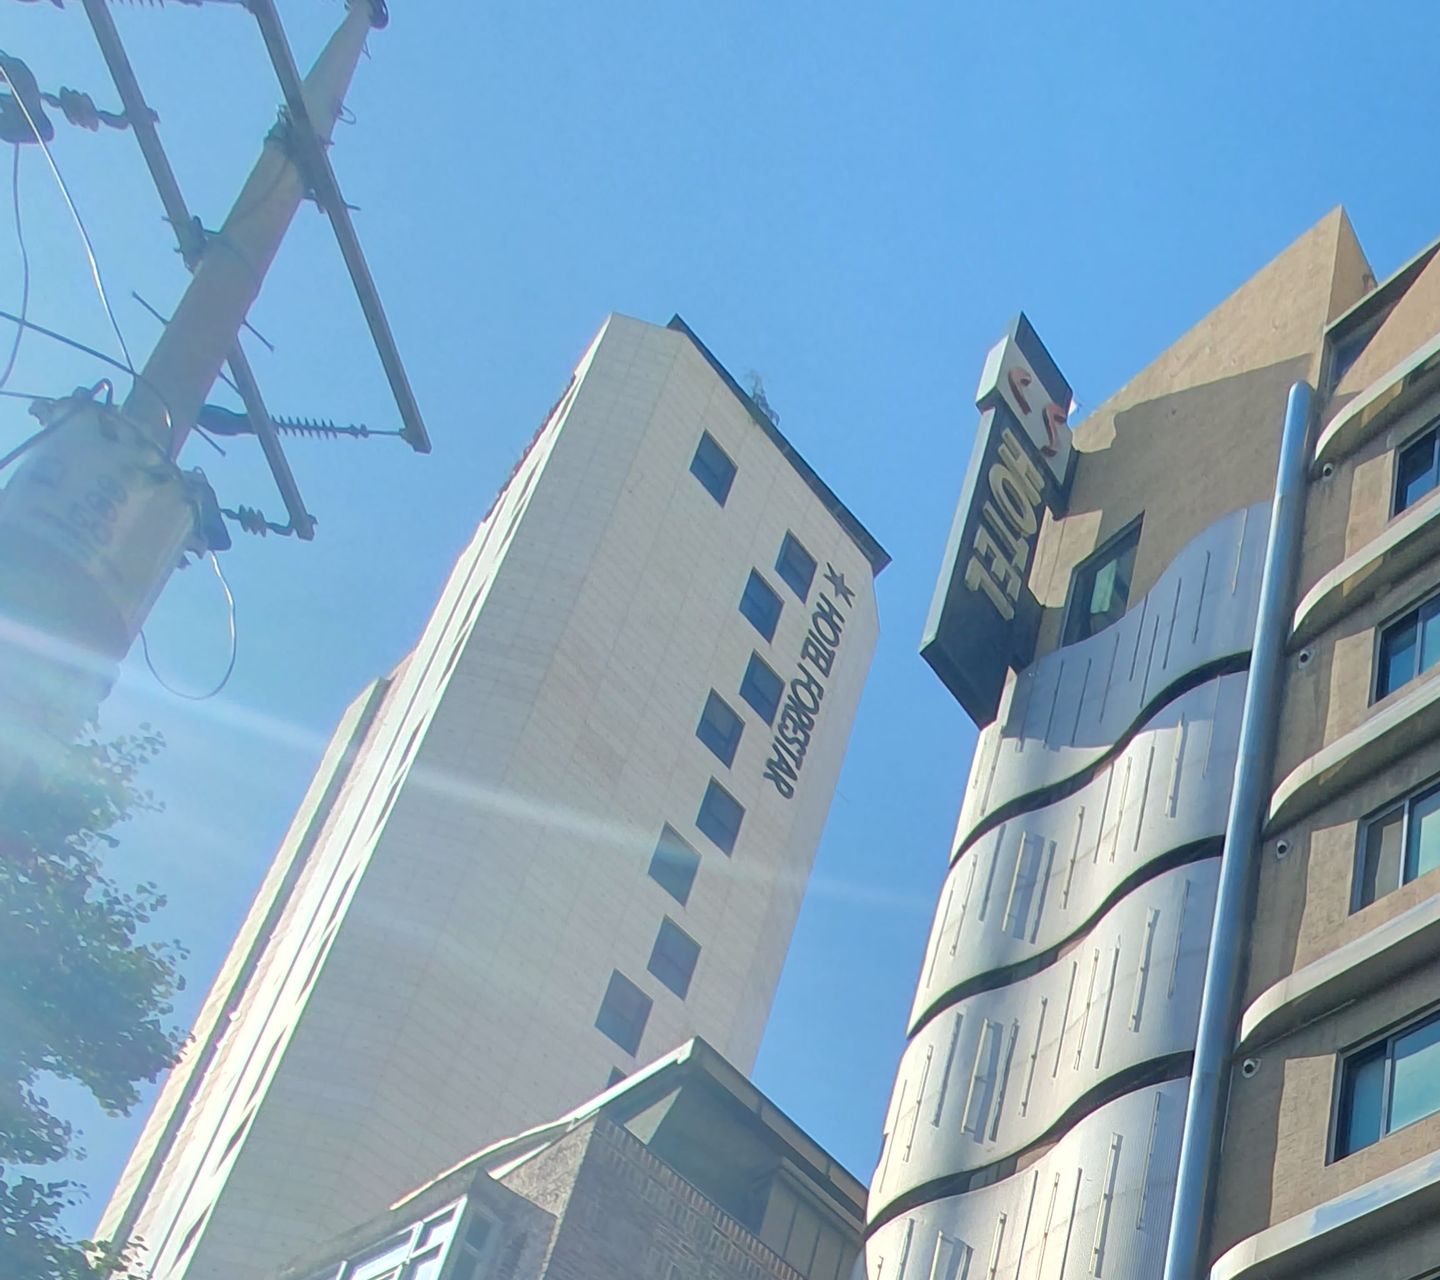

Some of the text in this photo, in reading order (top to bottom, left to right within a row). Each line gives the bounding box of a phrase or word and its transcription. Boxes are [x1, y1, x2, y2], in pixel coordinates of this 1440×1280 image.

[965, 430, 1046, 621] HOTEL
[763, 592, 846, 800] HOTEL FORESTAR
